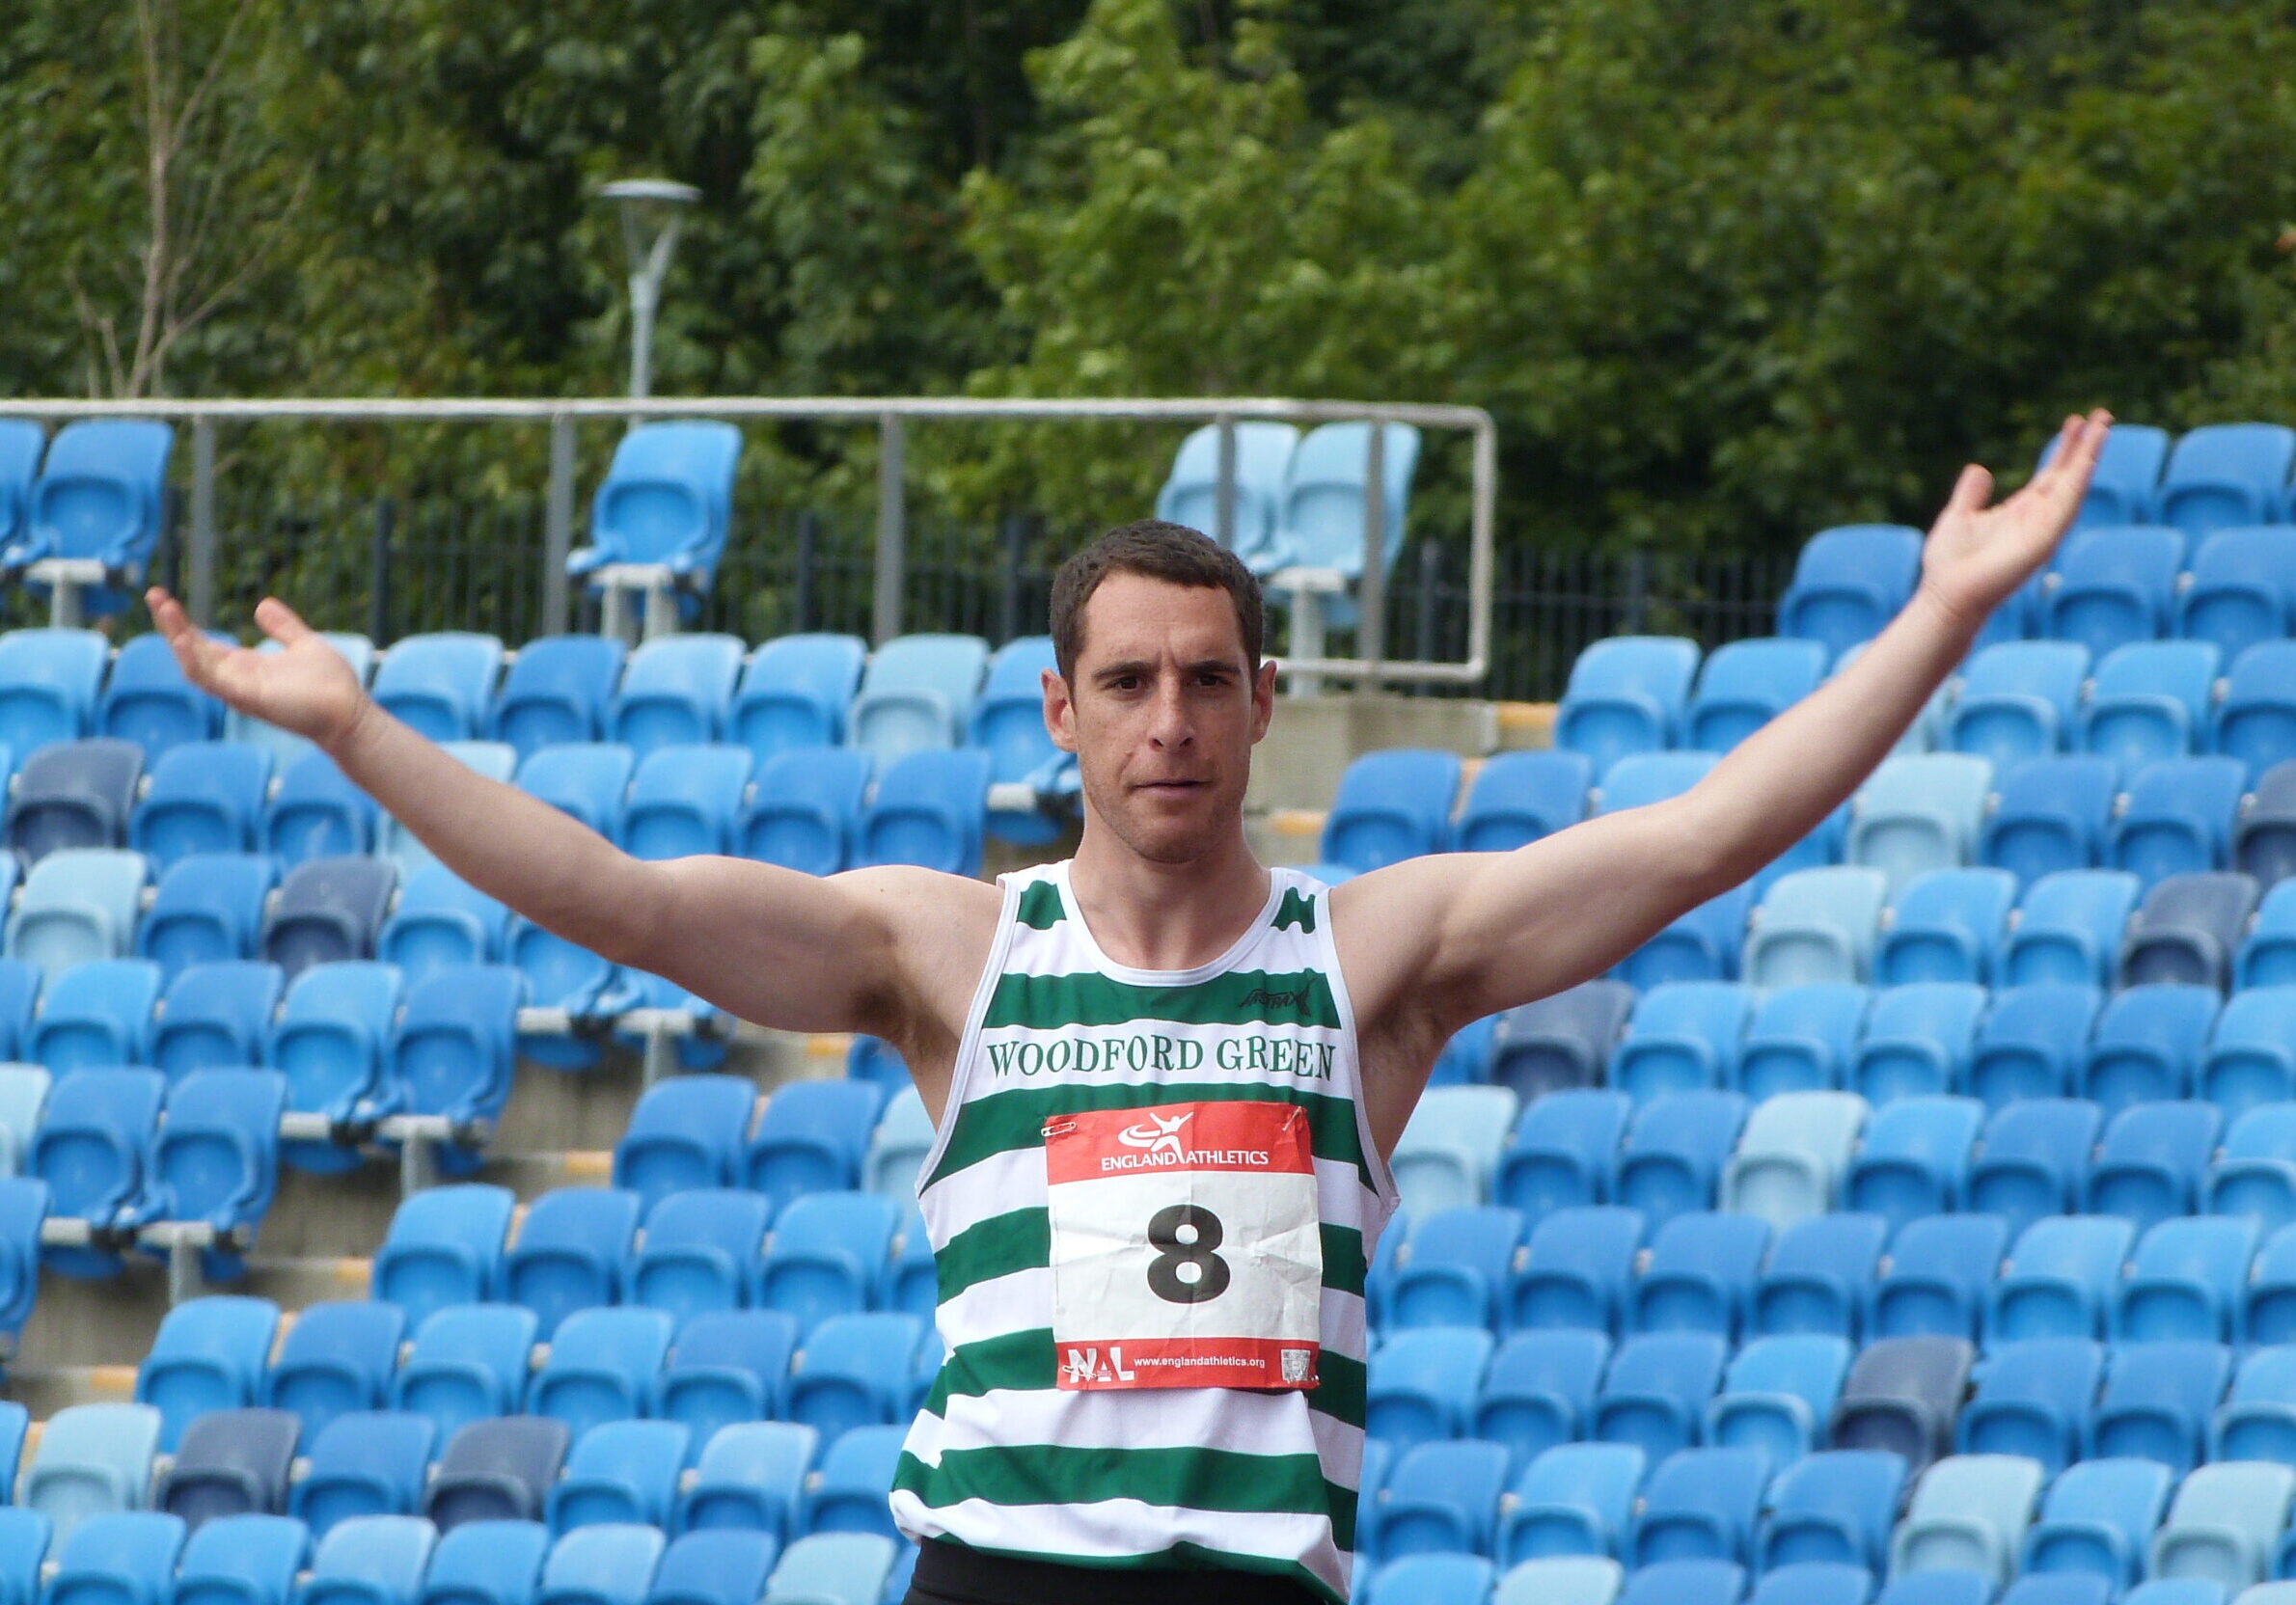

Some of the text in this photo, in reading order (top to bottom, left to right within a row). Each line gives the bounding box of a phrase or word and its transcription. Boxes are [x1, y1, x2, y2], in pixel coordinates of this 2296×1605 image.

[987, 1035, 1336, 1081] WOODFORD GREEN
[1101, 1151, 1269, 1171] ENGLAND ATHLETICS
[1147, 1204, 1230, 1304] 8
[1134, 1356, 1265, 1368] www.englandathletics.org
